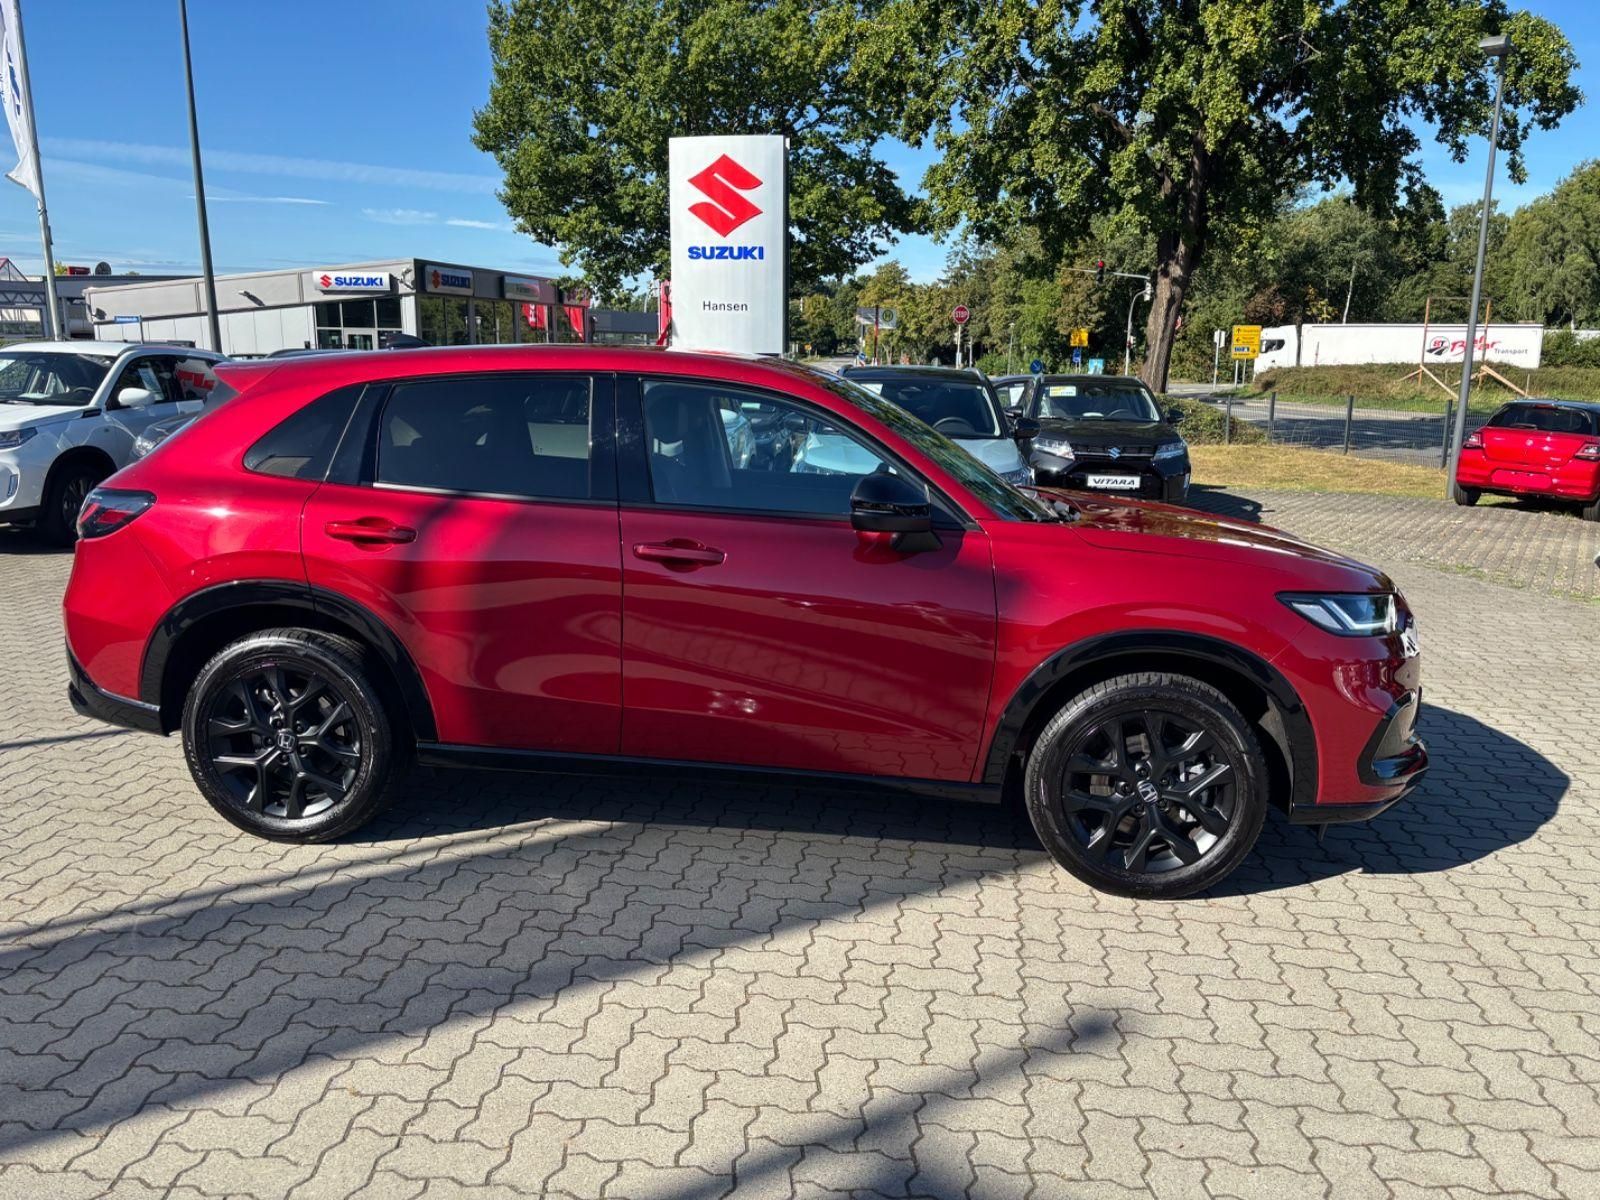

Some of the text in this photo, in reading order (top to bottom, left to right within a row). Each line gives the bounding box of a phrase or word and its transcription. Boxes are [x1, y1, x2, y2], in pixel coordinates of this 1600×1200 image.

[688, 246, 764, 260] SUZUKI
[334, 277, 384, 287] SUZUKI
[442, 275, 471, 288] SUZUKI
[703, 301, 748, 311] Hansen
[1092, 478, 1135, 486] VITARA
